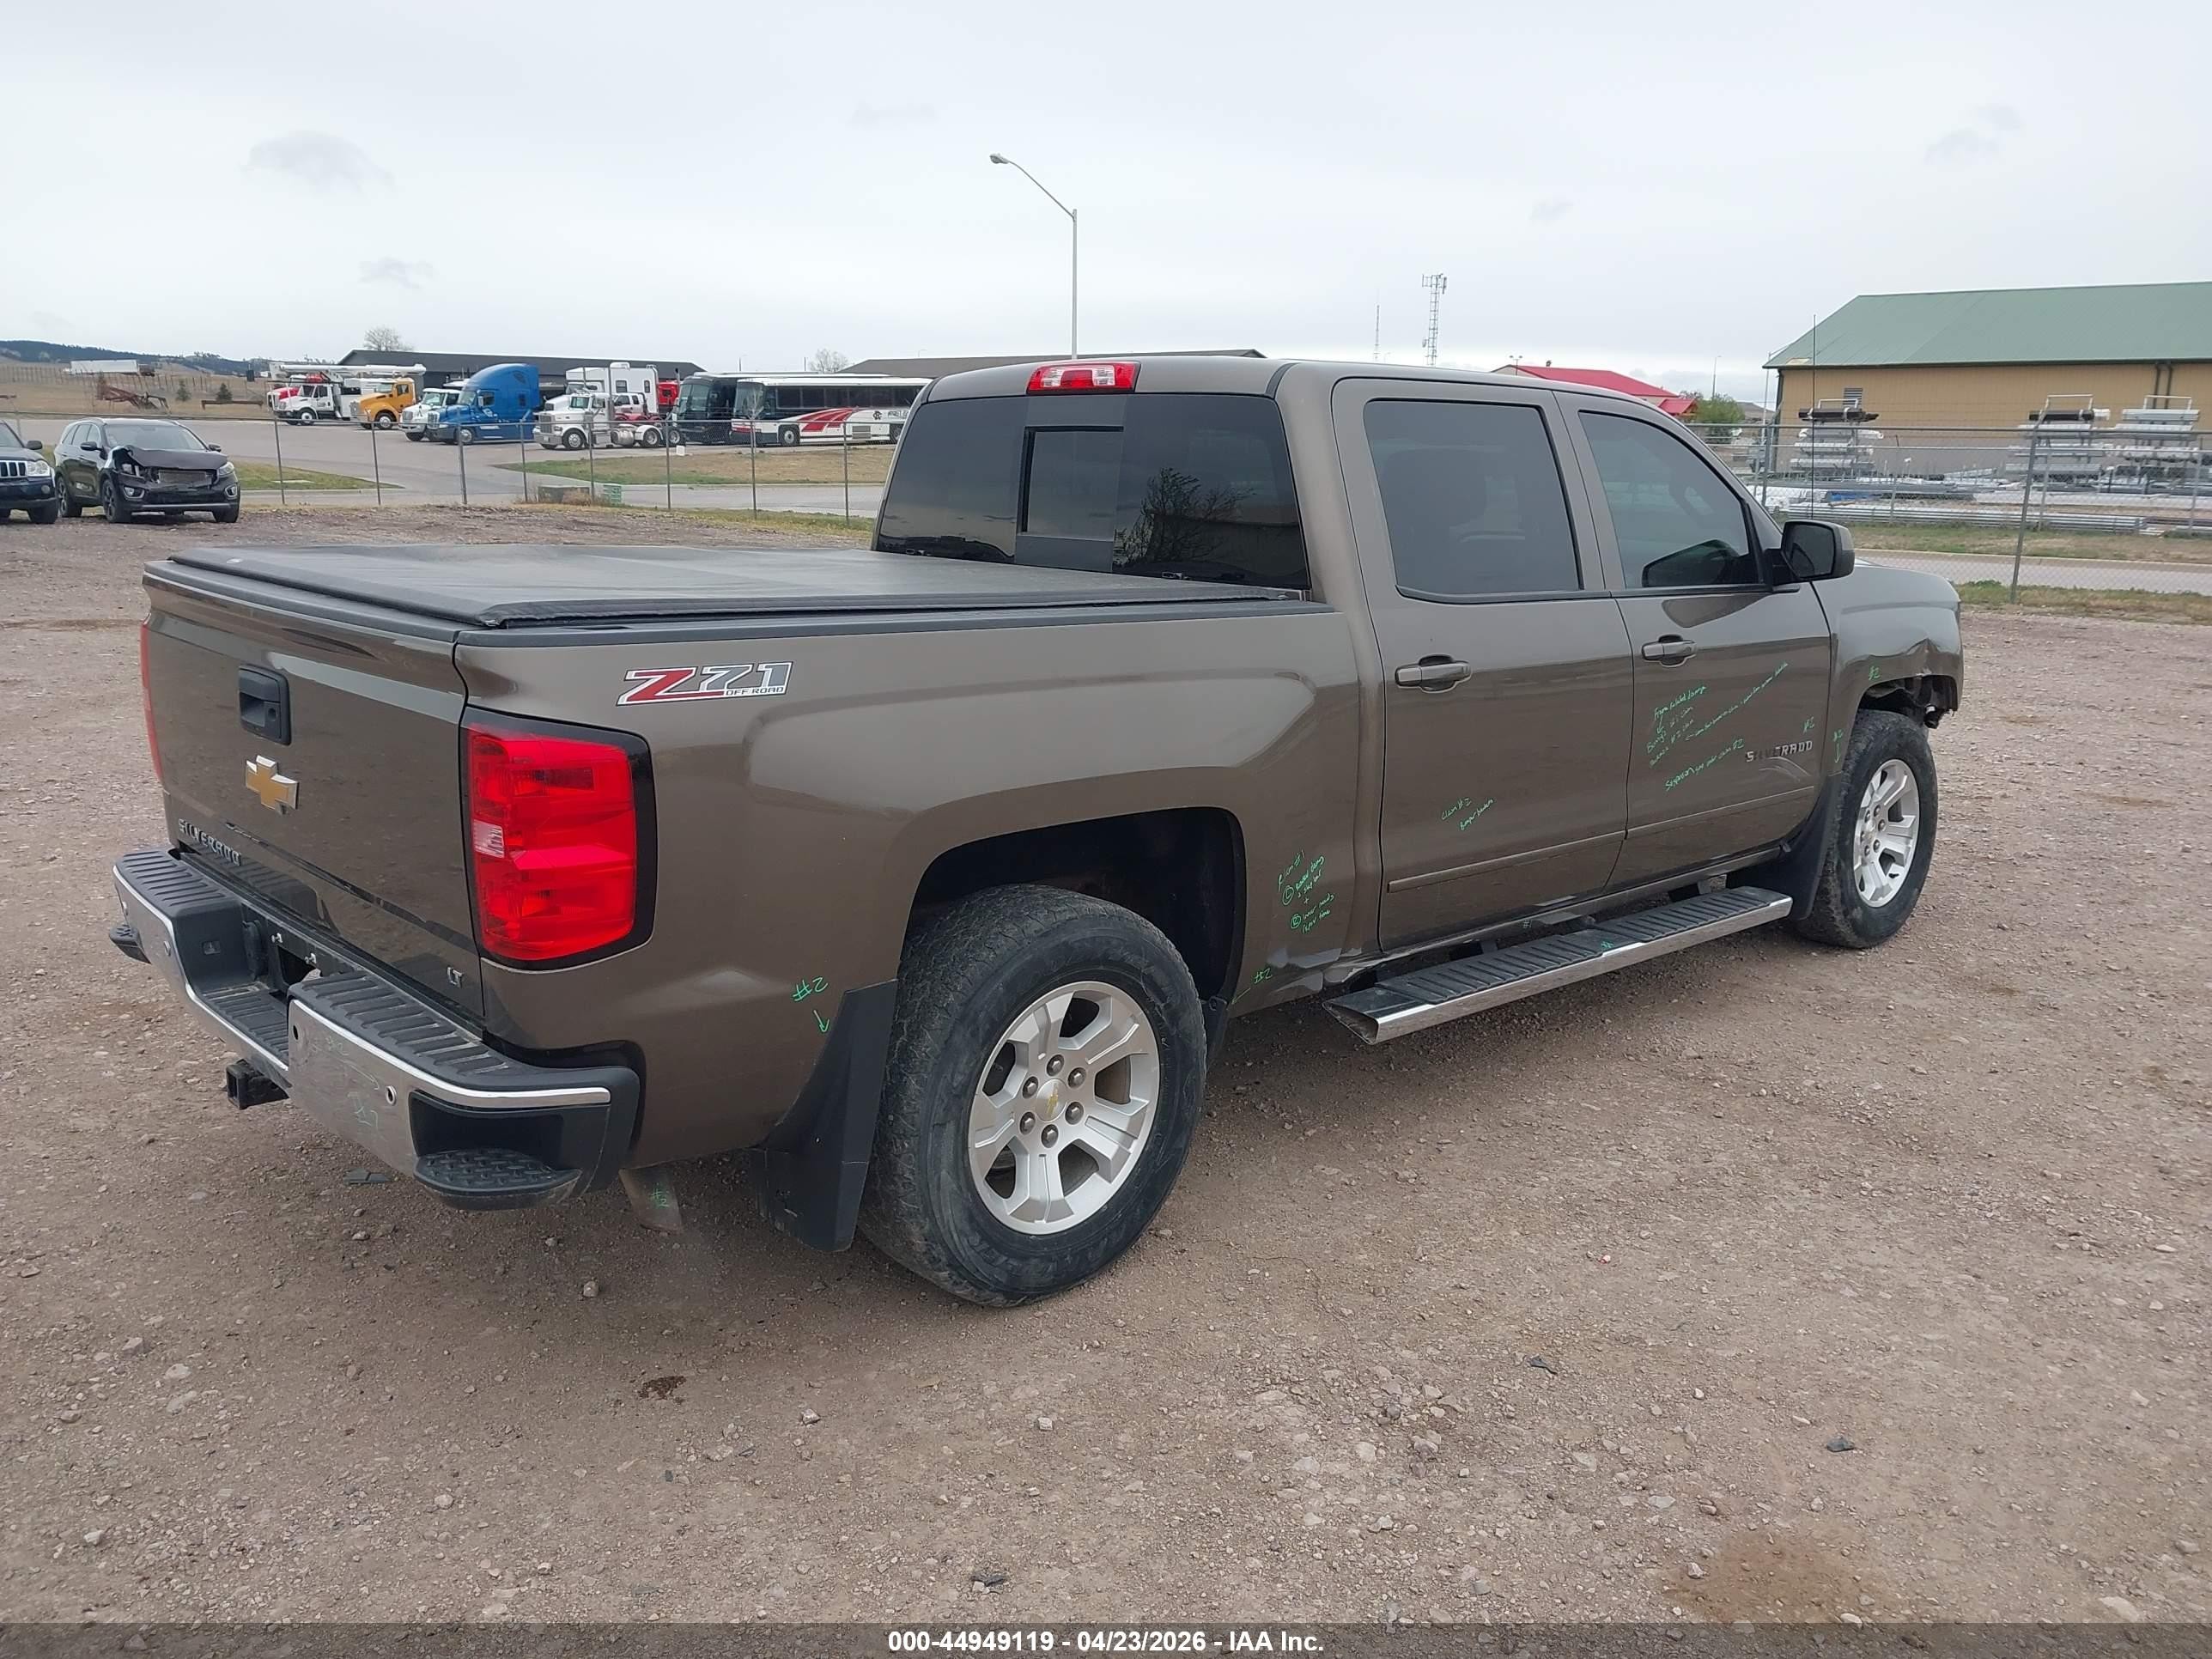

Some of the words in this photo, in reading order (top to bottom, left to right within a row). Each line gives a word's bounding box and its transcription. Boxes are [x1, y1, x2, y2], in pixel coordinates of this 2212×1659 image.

[616, 661, 793, 707] Z71
[751, 686, 785, 695] ROAD
[178, 818, 242, 867] SILVERADO
[447, 966, 463, 989] LT
[792, 976, 829, 1002] #2
